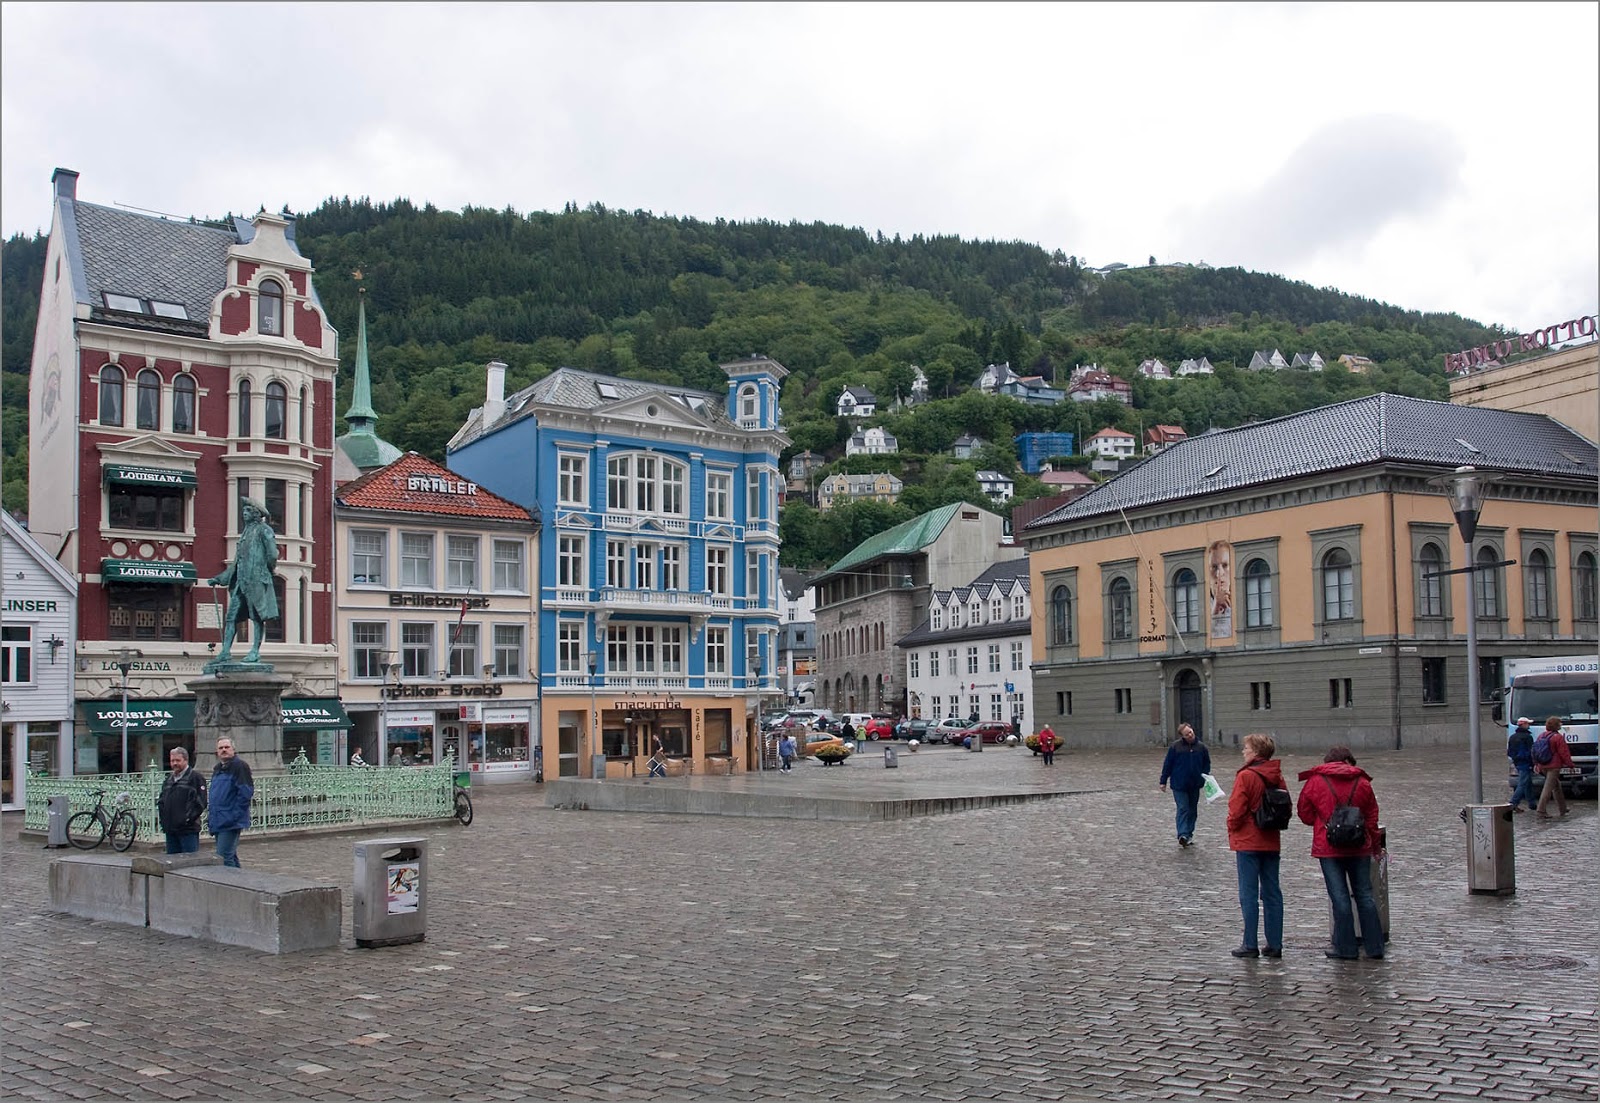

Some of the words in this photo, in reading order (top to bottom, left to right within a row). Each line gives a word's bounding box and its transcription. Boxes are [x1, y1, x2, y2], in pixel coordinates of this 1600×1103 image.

[1444, 339, 1512, 373] BANCO
[1519, 315, 1596, 353] ROTTO
[119, 471, 183, 483] LOUISIANA
[408, 477, 478, 495] BRILLER
[119, 567, 184, 579] LOUISIANA
[1140, 634, 1167, 643] FORMAT
[102, 661, 171, 671] LOISIANA
[1557, 664, 1573, 672] 800
[1575, 664, 1586, 672] 80
[1588, 663, 1598, 671] 33
[615, 698, 682, 709] macumba
